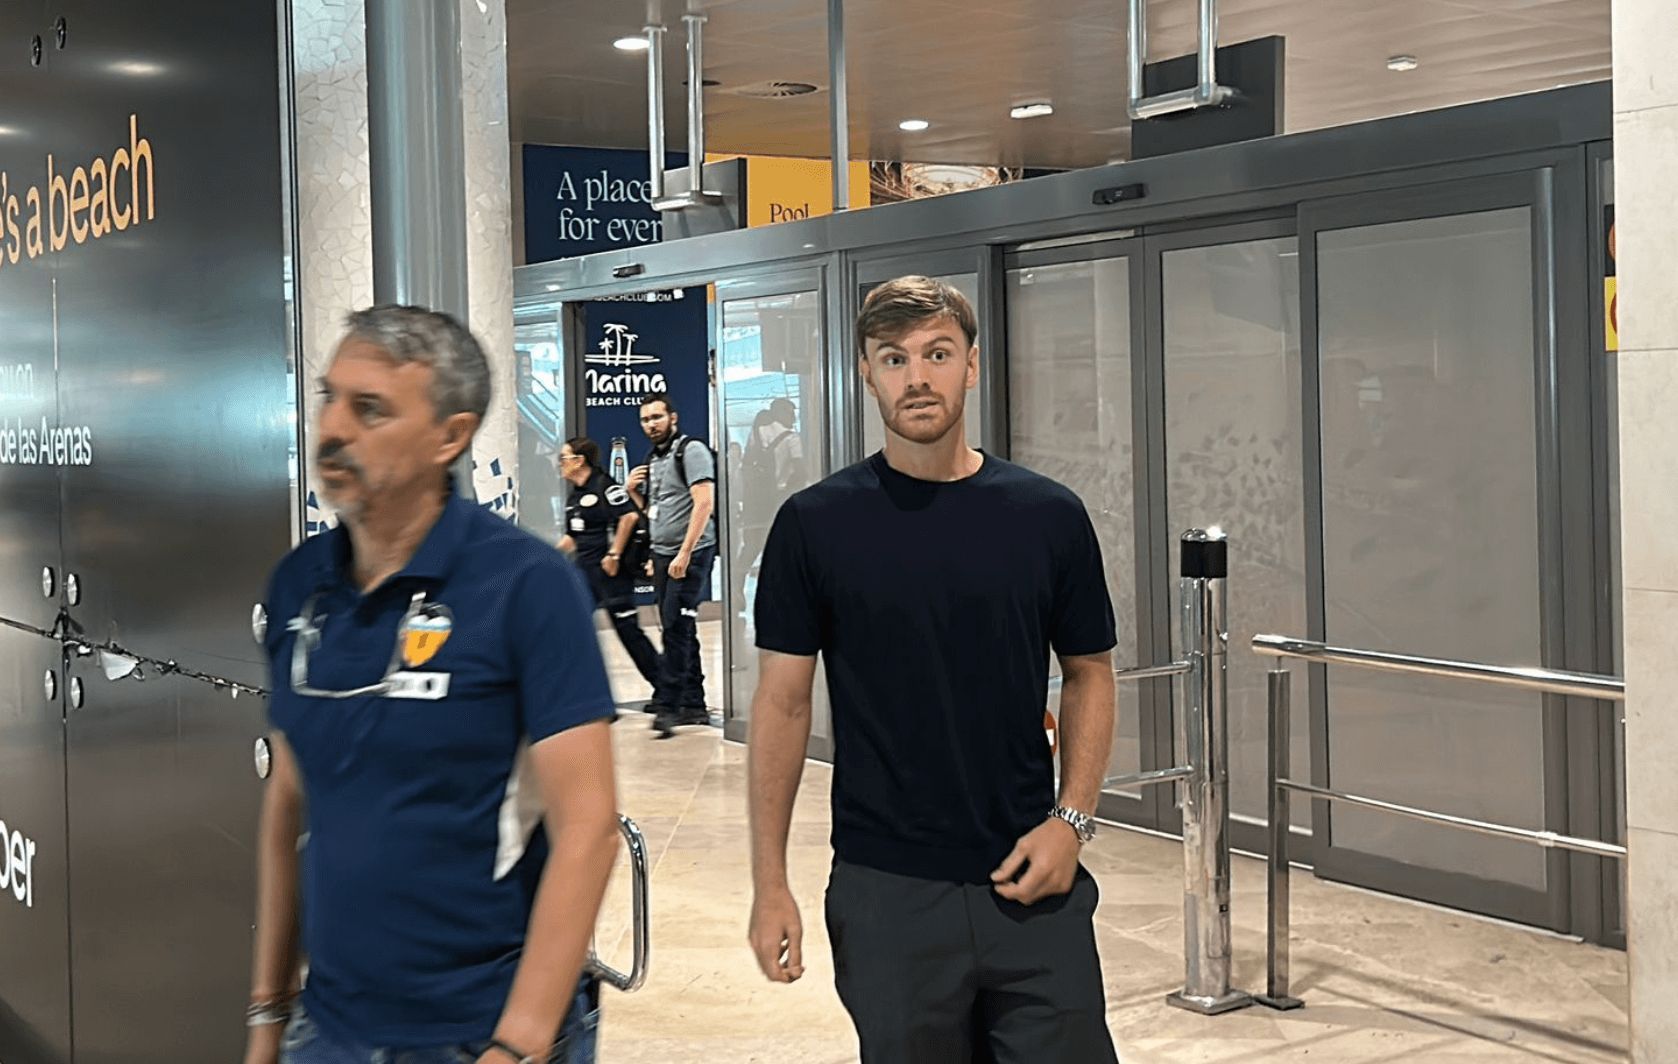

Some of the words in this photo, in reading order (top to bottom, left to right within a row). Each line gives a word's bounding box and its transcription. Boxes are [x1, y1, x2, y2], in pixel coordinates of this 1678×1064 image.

[26, 186, 43, 259] a
[48, 114, 154, 252] beach
[556, 171, 577, 200] A
[584, 170, 652, 211] place
[559, 207, 600, 241] for
[769, 203, 809, 223] Pool
[623, 397, 645, 405] CLU
[0, 417, 17, 464] de
[18, 416, 37, 464] las
[39, 416, 92, 466] Arenas
